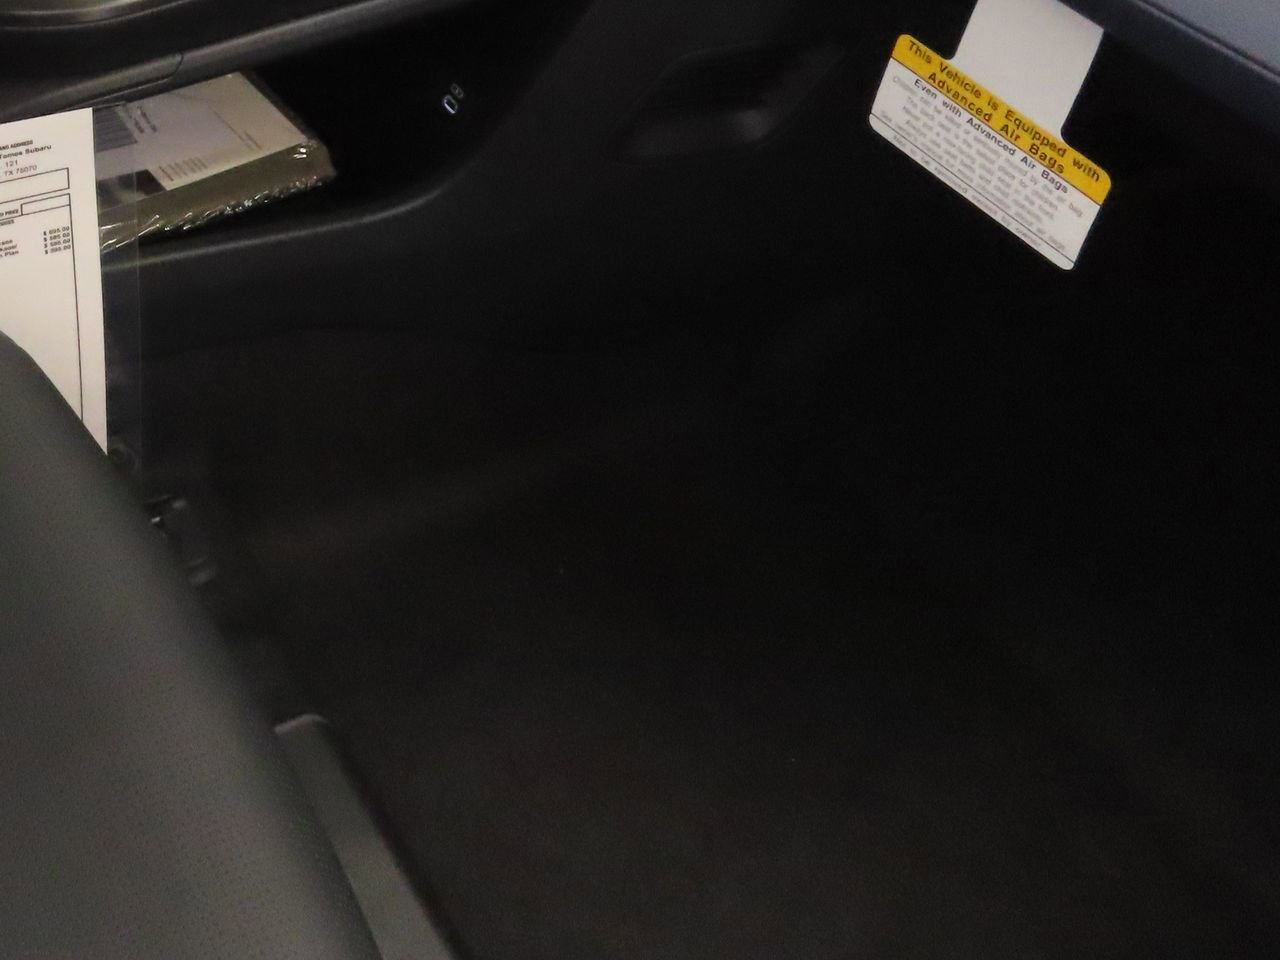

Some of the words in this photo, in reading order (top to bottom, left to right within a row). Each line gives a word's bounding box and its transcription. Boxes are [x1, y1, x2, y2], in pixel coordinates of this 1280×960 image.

[25, 145, 52, 155] Subaru
[908, 40, 932, 64] This
[939, 62, 982, 99] Vehicle
[1004, 109, 1067, 158] Equipped
[1072, 157, 1100, 182] with
[914, 78, 938, 100] Even
[942, 100, 962, 118] with
[966, 117, 1016, 156] Advanced
[1020, 155, 1037, 170] Air
[1040, 169, 1069, 194] Bags
[928, 72, 993, 122] Advanced
[1000, 123, 1021, 142] Air
[1029, 143, 1065, 174] Bags
